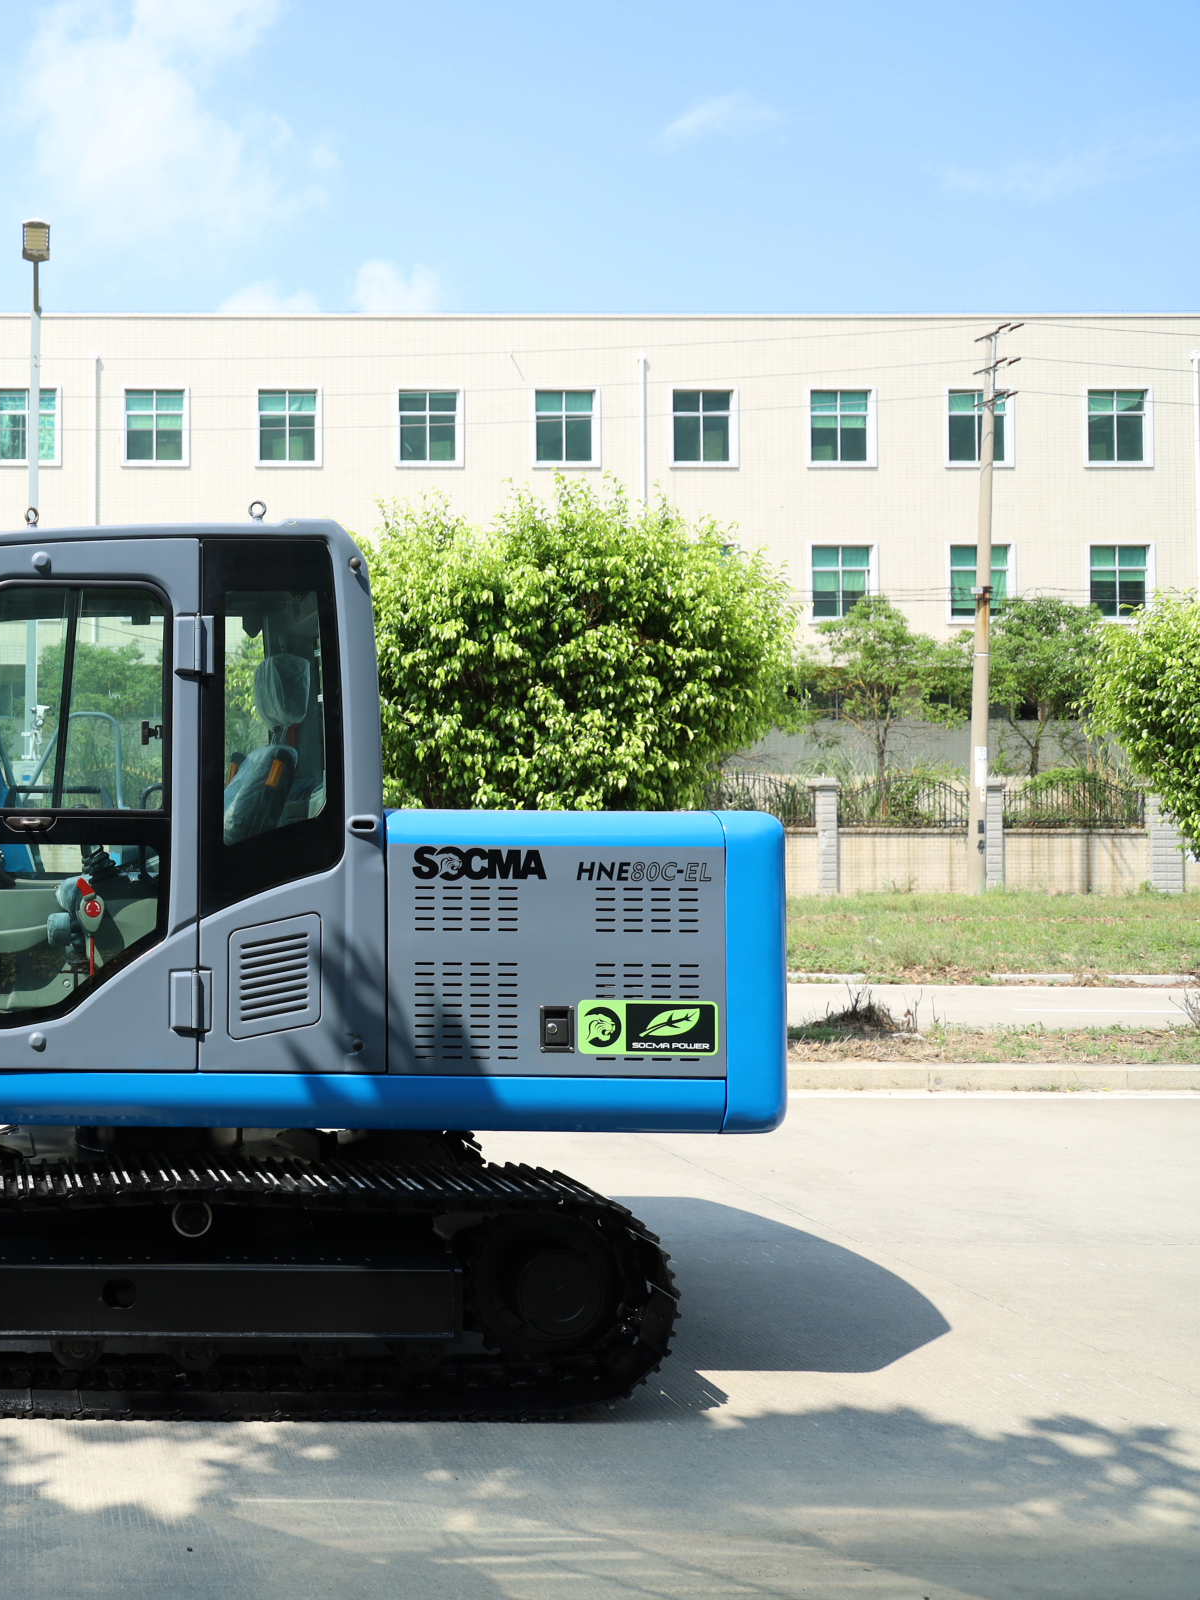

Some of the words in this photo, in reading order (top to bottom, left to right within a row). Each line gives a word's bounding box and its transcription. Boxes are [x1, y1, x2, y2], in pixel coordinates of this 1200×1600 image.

[412, 845, 547, 881] SOCMA
[576, 861, 712, 882] HNE80C-EL
[671, 1042, 710, 1050] POWER
